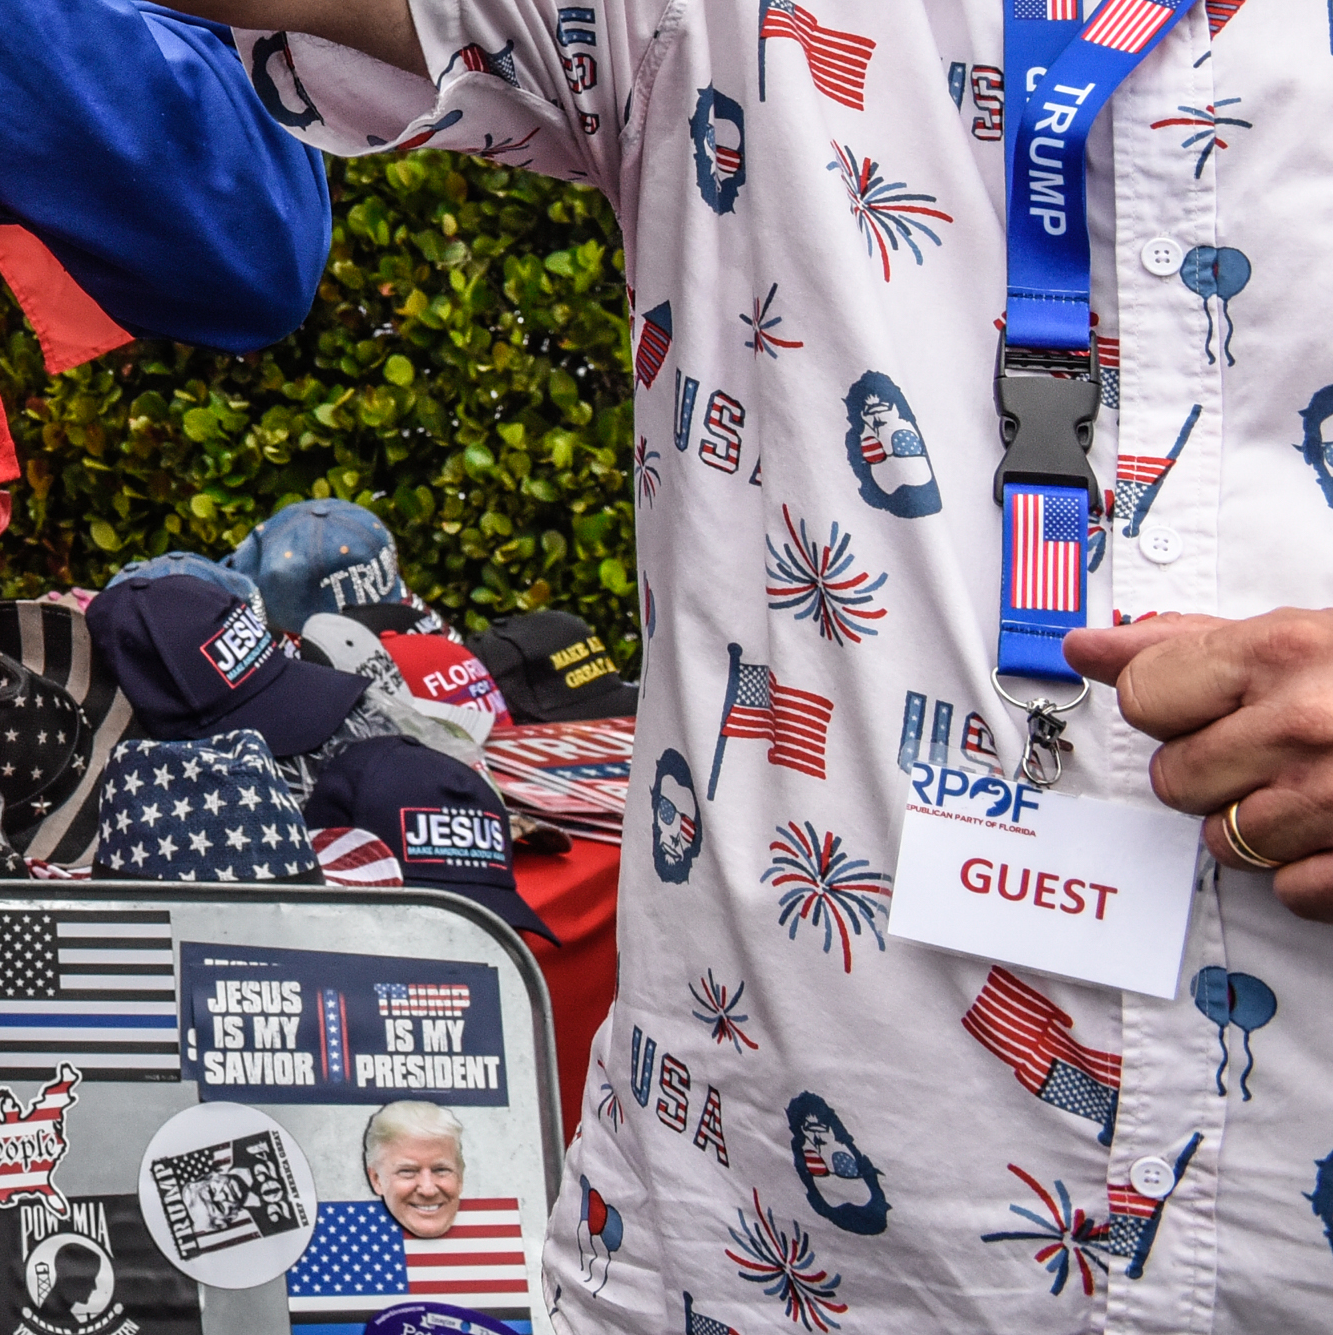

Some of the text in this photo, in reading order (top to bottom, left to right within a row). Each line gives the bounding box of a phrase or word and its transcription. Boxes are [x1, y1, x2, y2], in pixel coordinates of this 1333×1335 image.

[1028, 83, 1096, 236] TRUMP
[672, 367, 762, 488] US
[320, 544, 398, 613] TRU
[485, 732, 634, 763] TRU
[406, 813, 505, 852] JESUS
[906, 803, 1037, 837] EPUBLICAN PARTY OF FLORIDA
[960, 857, 1118, 920] GUEST
[207, 980, 303, 1014] JESUS
[373, 983, 471, 1017] TRUMP
[213, 1015, 244, 1049] IS
[253, 1016, 300, 1050] MY
[385, 1018, 465, 1053] IS MY
[203, 1051, 316, 1085] SAVIOR
[355, 1054, 501, 1090] PRESIDENT
[632, 1023, 730, 1168] USA
[246, 1141, 292, 1223] 2024
[153, 1163, 198, 1253] TRUMP
[20, 1201, 114, 1263] POW MIA
